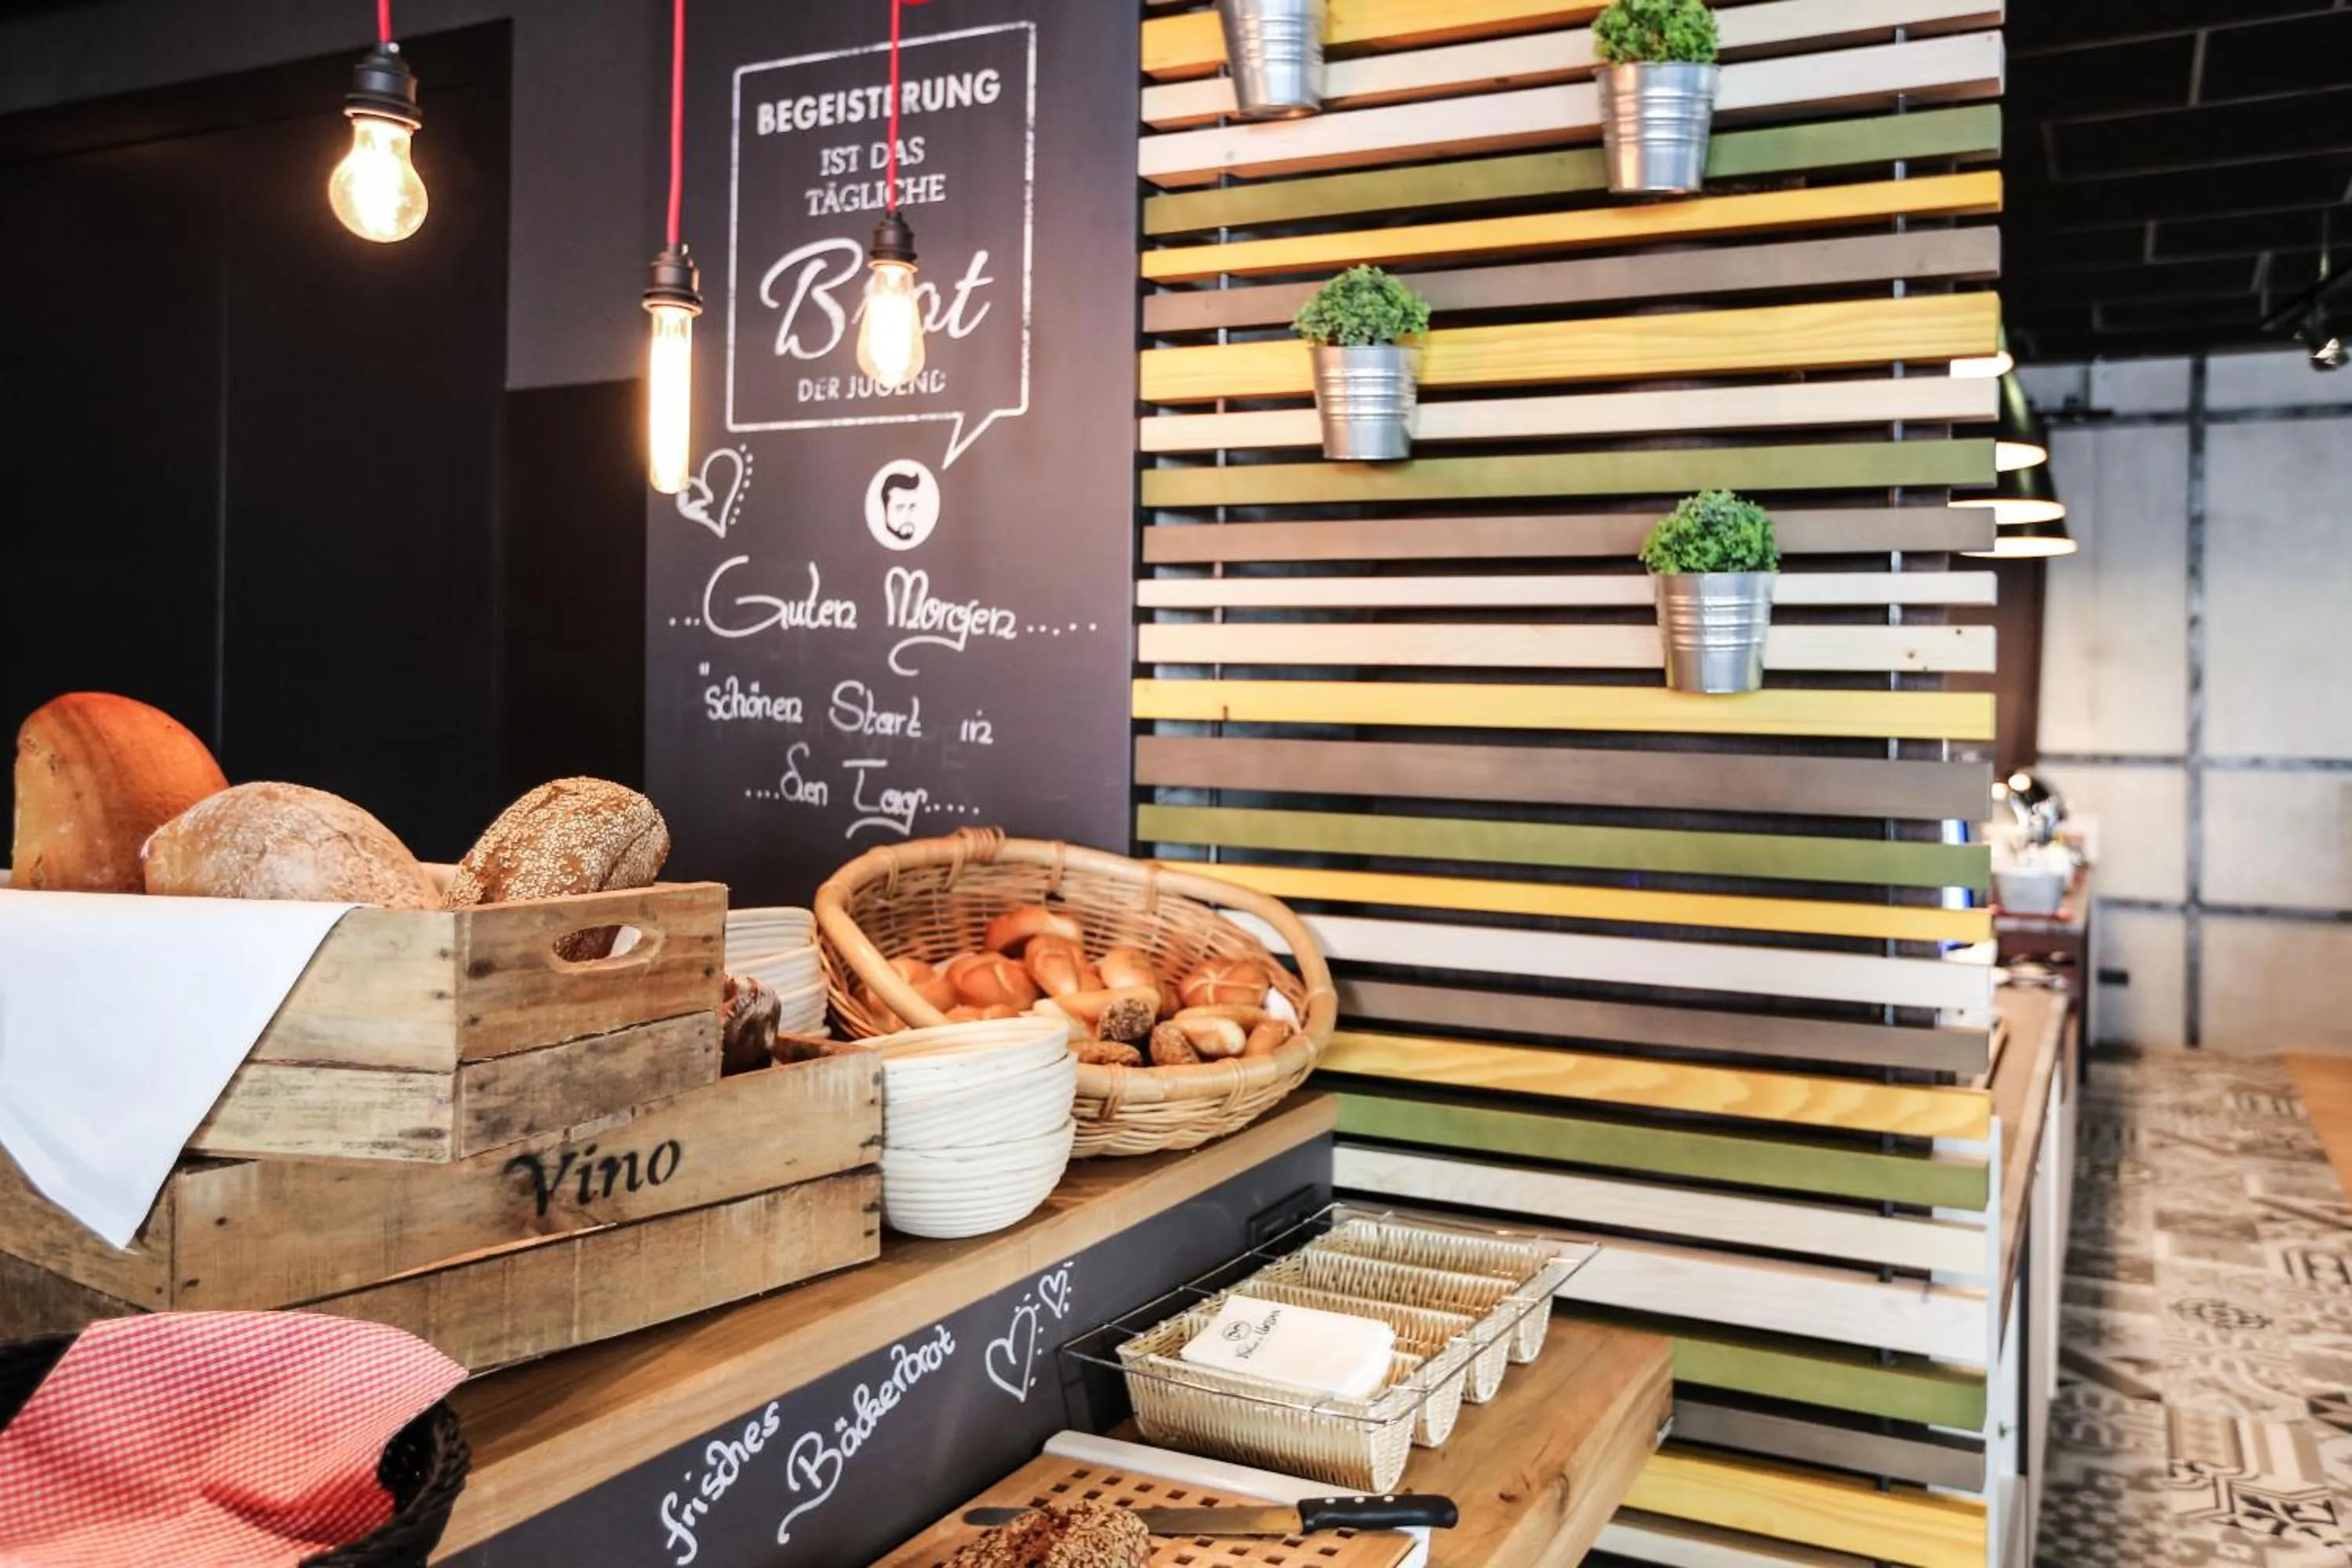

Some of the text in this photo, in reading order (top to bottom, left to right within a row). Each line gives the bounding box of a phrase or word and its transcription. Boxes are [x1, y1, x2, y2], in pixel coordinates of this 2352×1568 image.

[819, 144, 861, 176] IST
[797, 376, 840, 403] DER
[829, 680, 922, 738] Start
[960, 710, 994, 744] in
[503, 1138, 682, 1218] Vino
[661, 1325, 956, 1566] frisches Bäckerbrot
